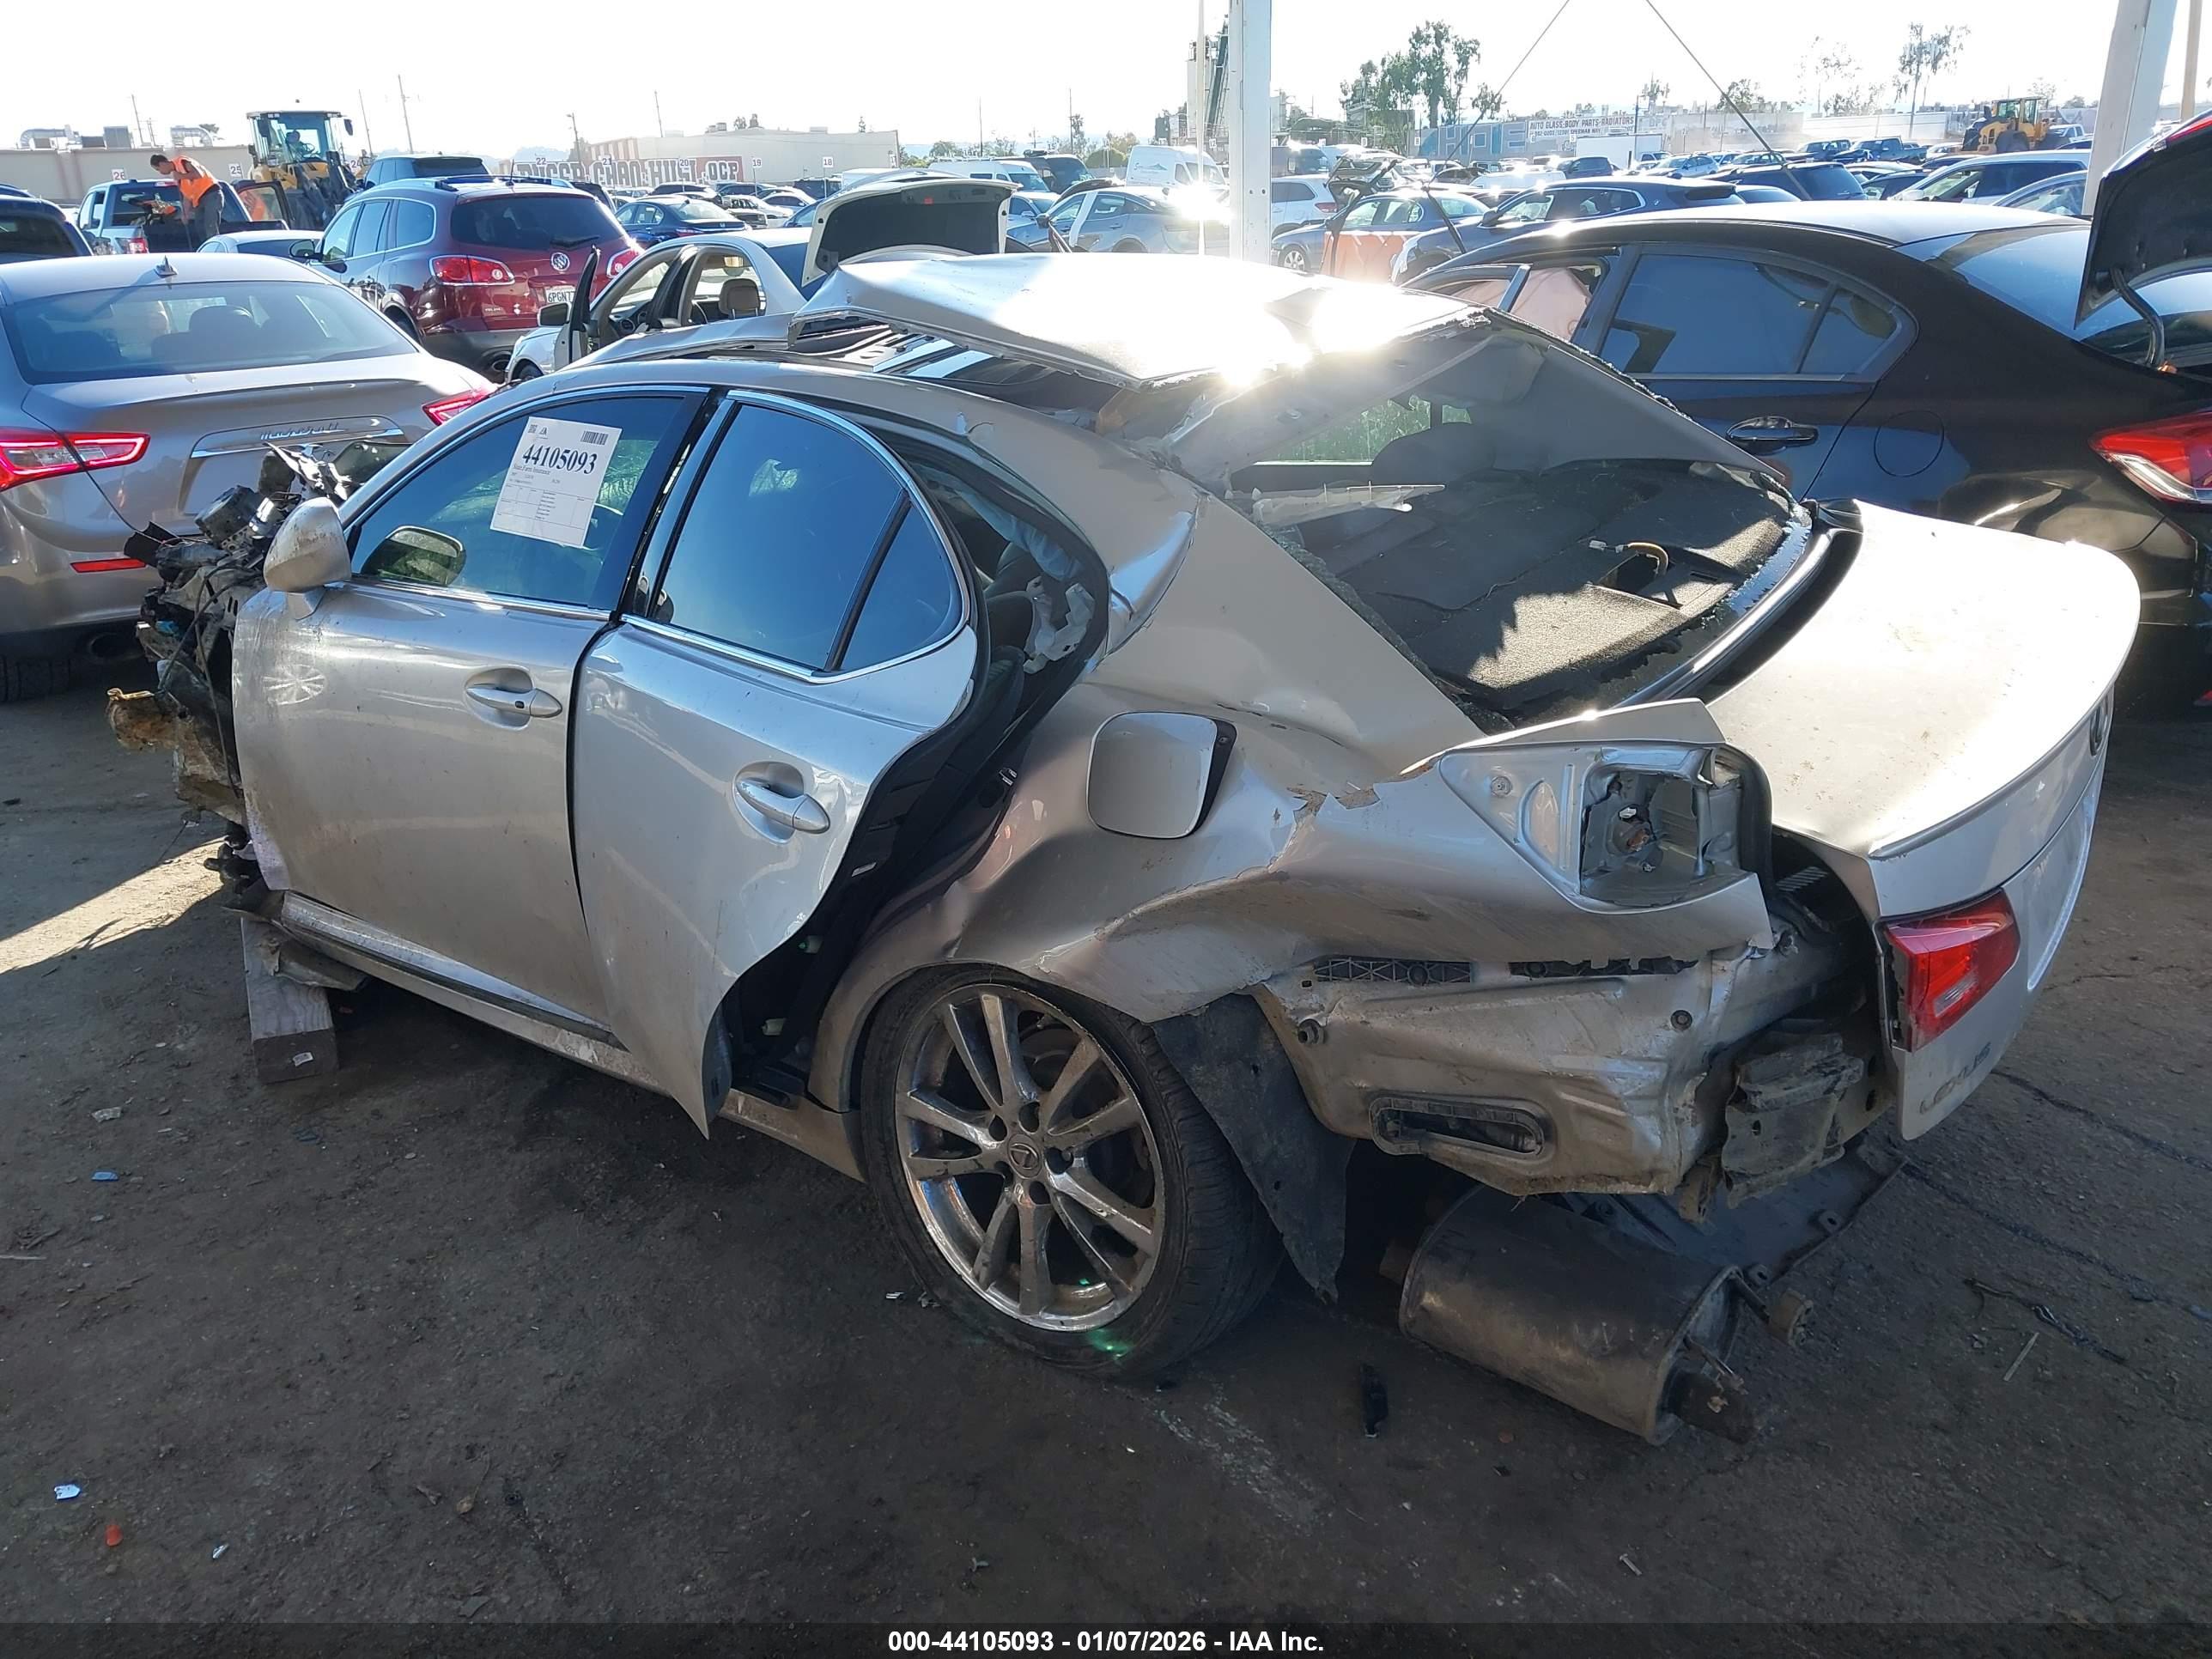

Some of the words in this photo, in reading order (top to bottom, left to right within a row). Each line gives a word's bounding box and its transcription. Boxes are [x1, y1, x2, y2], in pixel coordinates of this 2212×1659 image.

[536, 157, 547, 166] 22
[230, 166, 241, 174] 25
[112, 172, 125, 180] 26
[522, 444, 598, 474] 44105093
